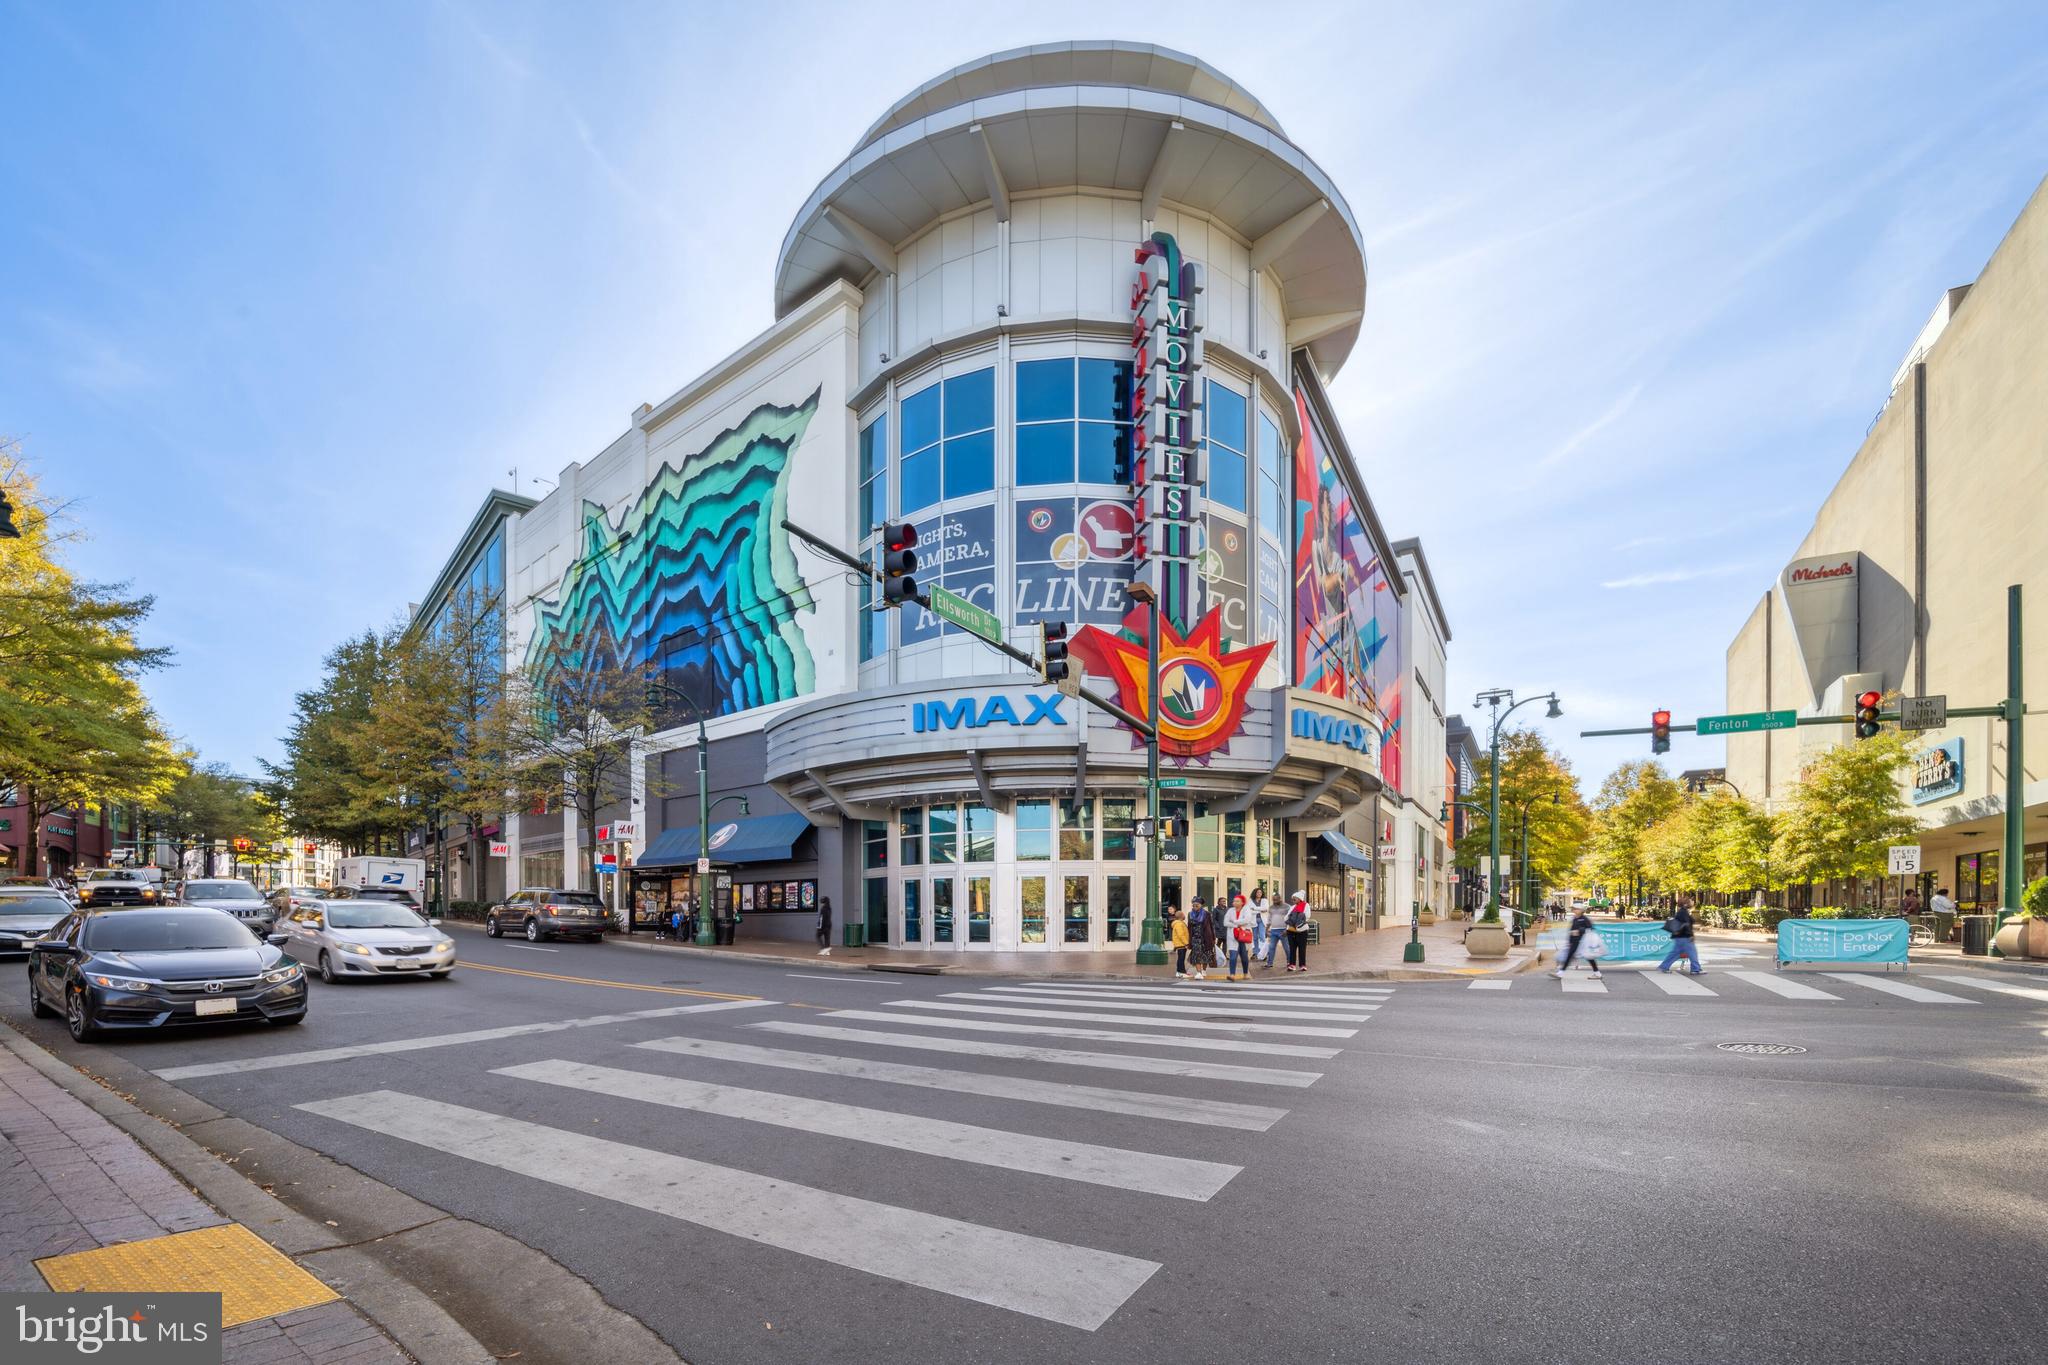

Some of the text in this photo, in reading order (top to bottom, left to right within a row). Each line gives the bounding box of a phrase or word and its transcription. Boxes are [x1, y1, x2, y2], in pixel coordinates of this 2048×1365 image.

[1164, 306, 1188, 514] MOVIES
[913, 522, 967, 550] IGHTS,
[916, 541, 990, 572] AMERA,
[936, 593, 980, 627] Ellsworth
[1915, 700, 1933, 708] NO
[913, 694, 1067, 733] IMAX
[1911, 709, 1937, 718] TURN
[1708, 712, 1776, 731] Fenton St
[1904, 718, 1943, 727] ON RED
[1291, 708, 1370, 754] IMAX
[1895, 860, 1915, 871] 15
[1630, 934, 1648, 942] Do
[1843, 932, 1894, 942] Do Not
[1630, 944, 1663, 952] Enter
[1843, 943, 1881, 952] Enter
